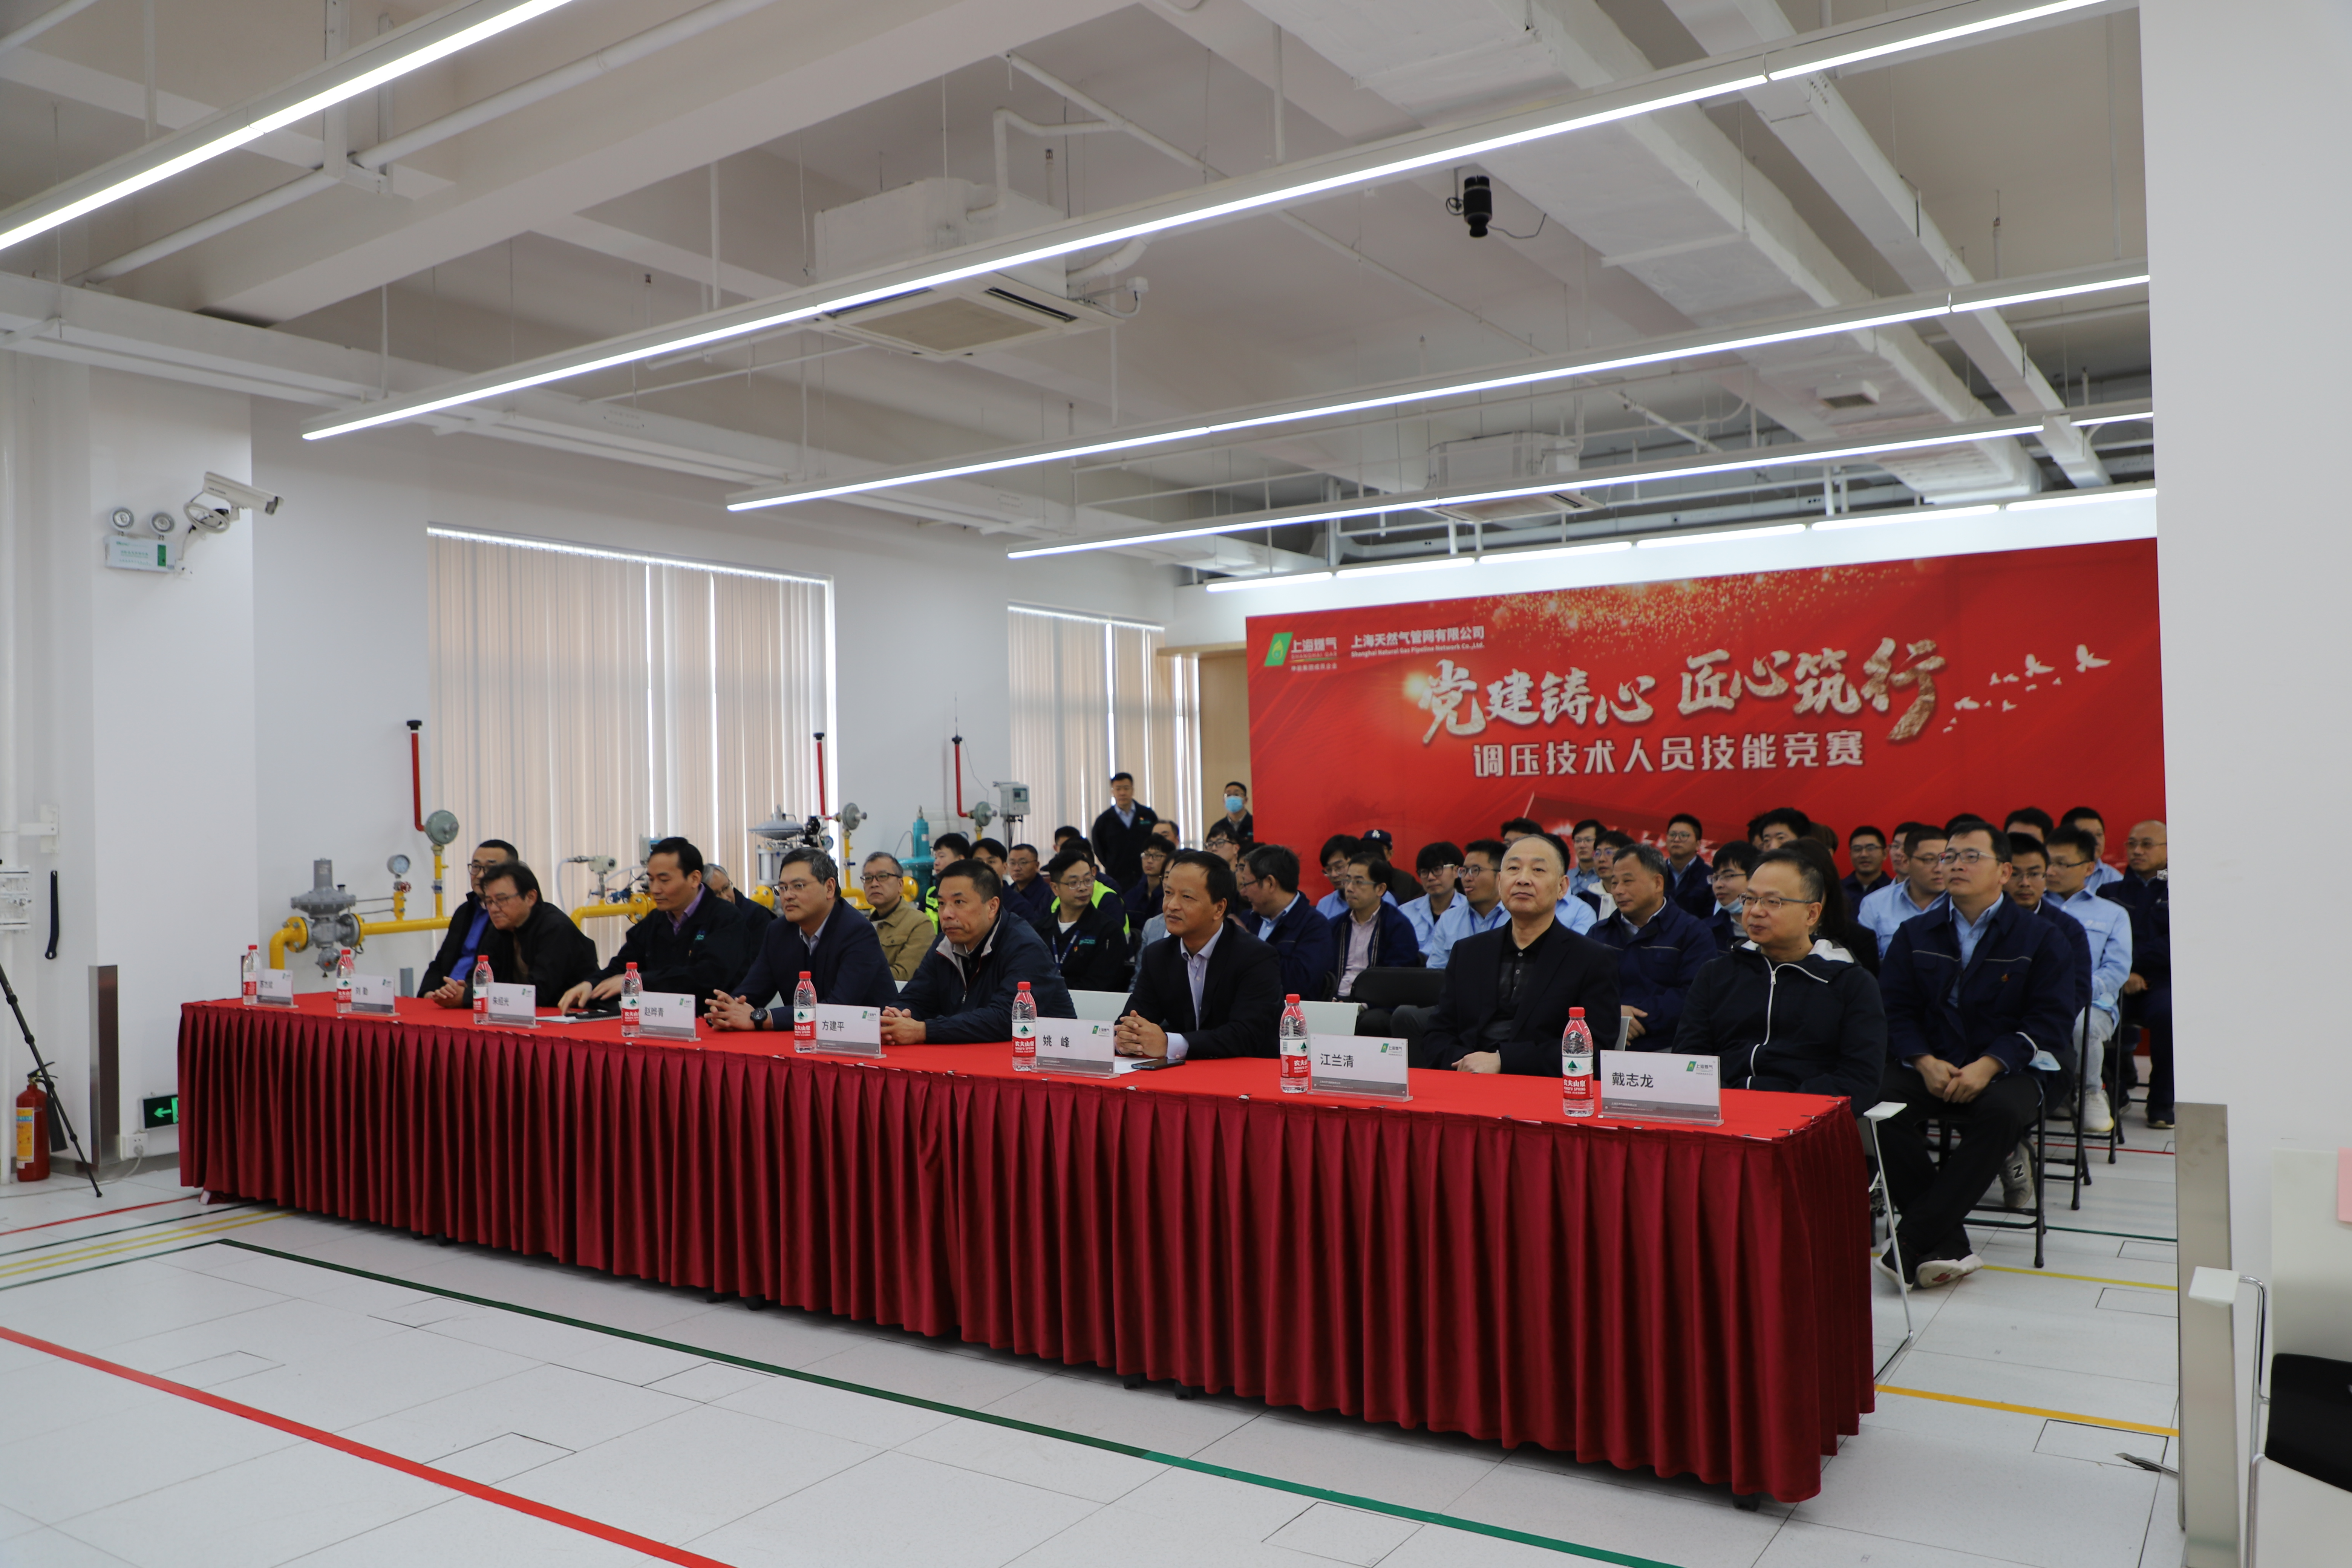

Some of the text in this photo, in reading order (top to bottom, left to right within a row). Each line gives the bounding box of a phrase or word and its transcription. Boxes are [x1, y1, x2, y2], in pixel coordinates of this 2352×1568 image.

[1351, 625, 1485, 648] 上海天然气管网有限公司
[1291, 637, 1337, 653] 上海燃气
[1351, 649, 1377, 658] Shanghai
[1378, 647, 1399, 655] Natural
[1411, 645, 1434, 653] Pipeline
[1436, 643, 1461, 651] Network
[1418, 637, 1946, 744] 党建铸心 匠心筑行
[1473, 730, 1864, 778] 调压技术人员技能竞赛
[822, 1020, 845, 1032] 方建平
[1320, 1053, 1354, 1068] 江兰清
[1563, 1079, 1586, 1087] 农夫山泉
[1612, 1072, 1654, 1088] 戴志龙
